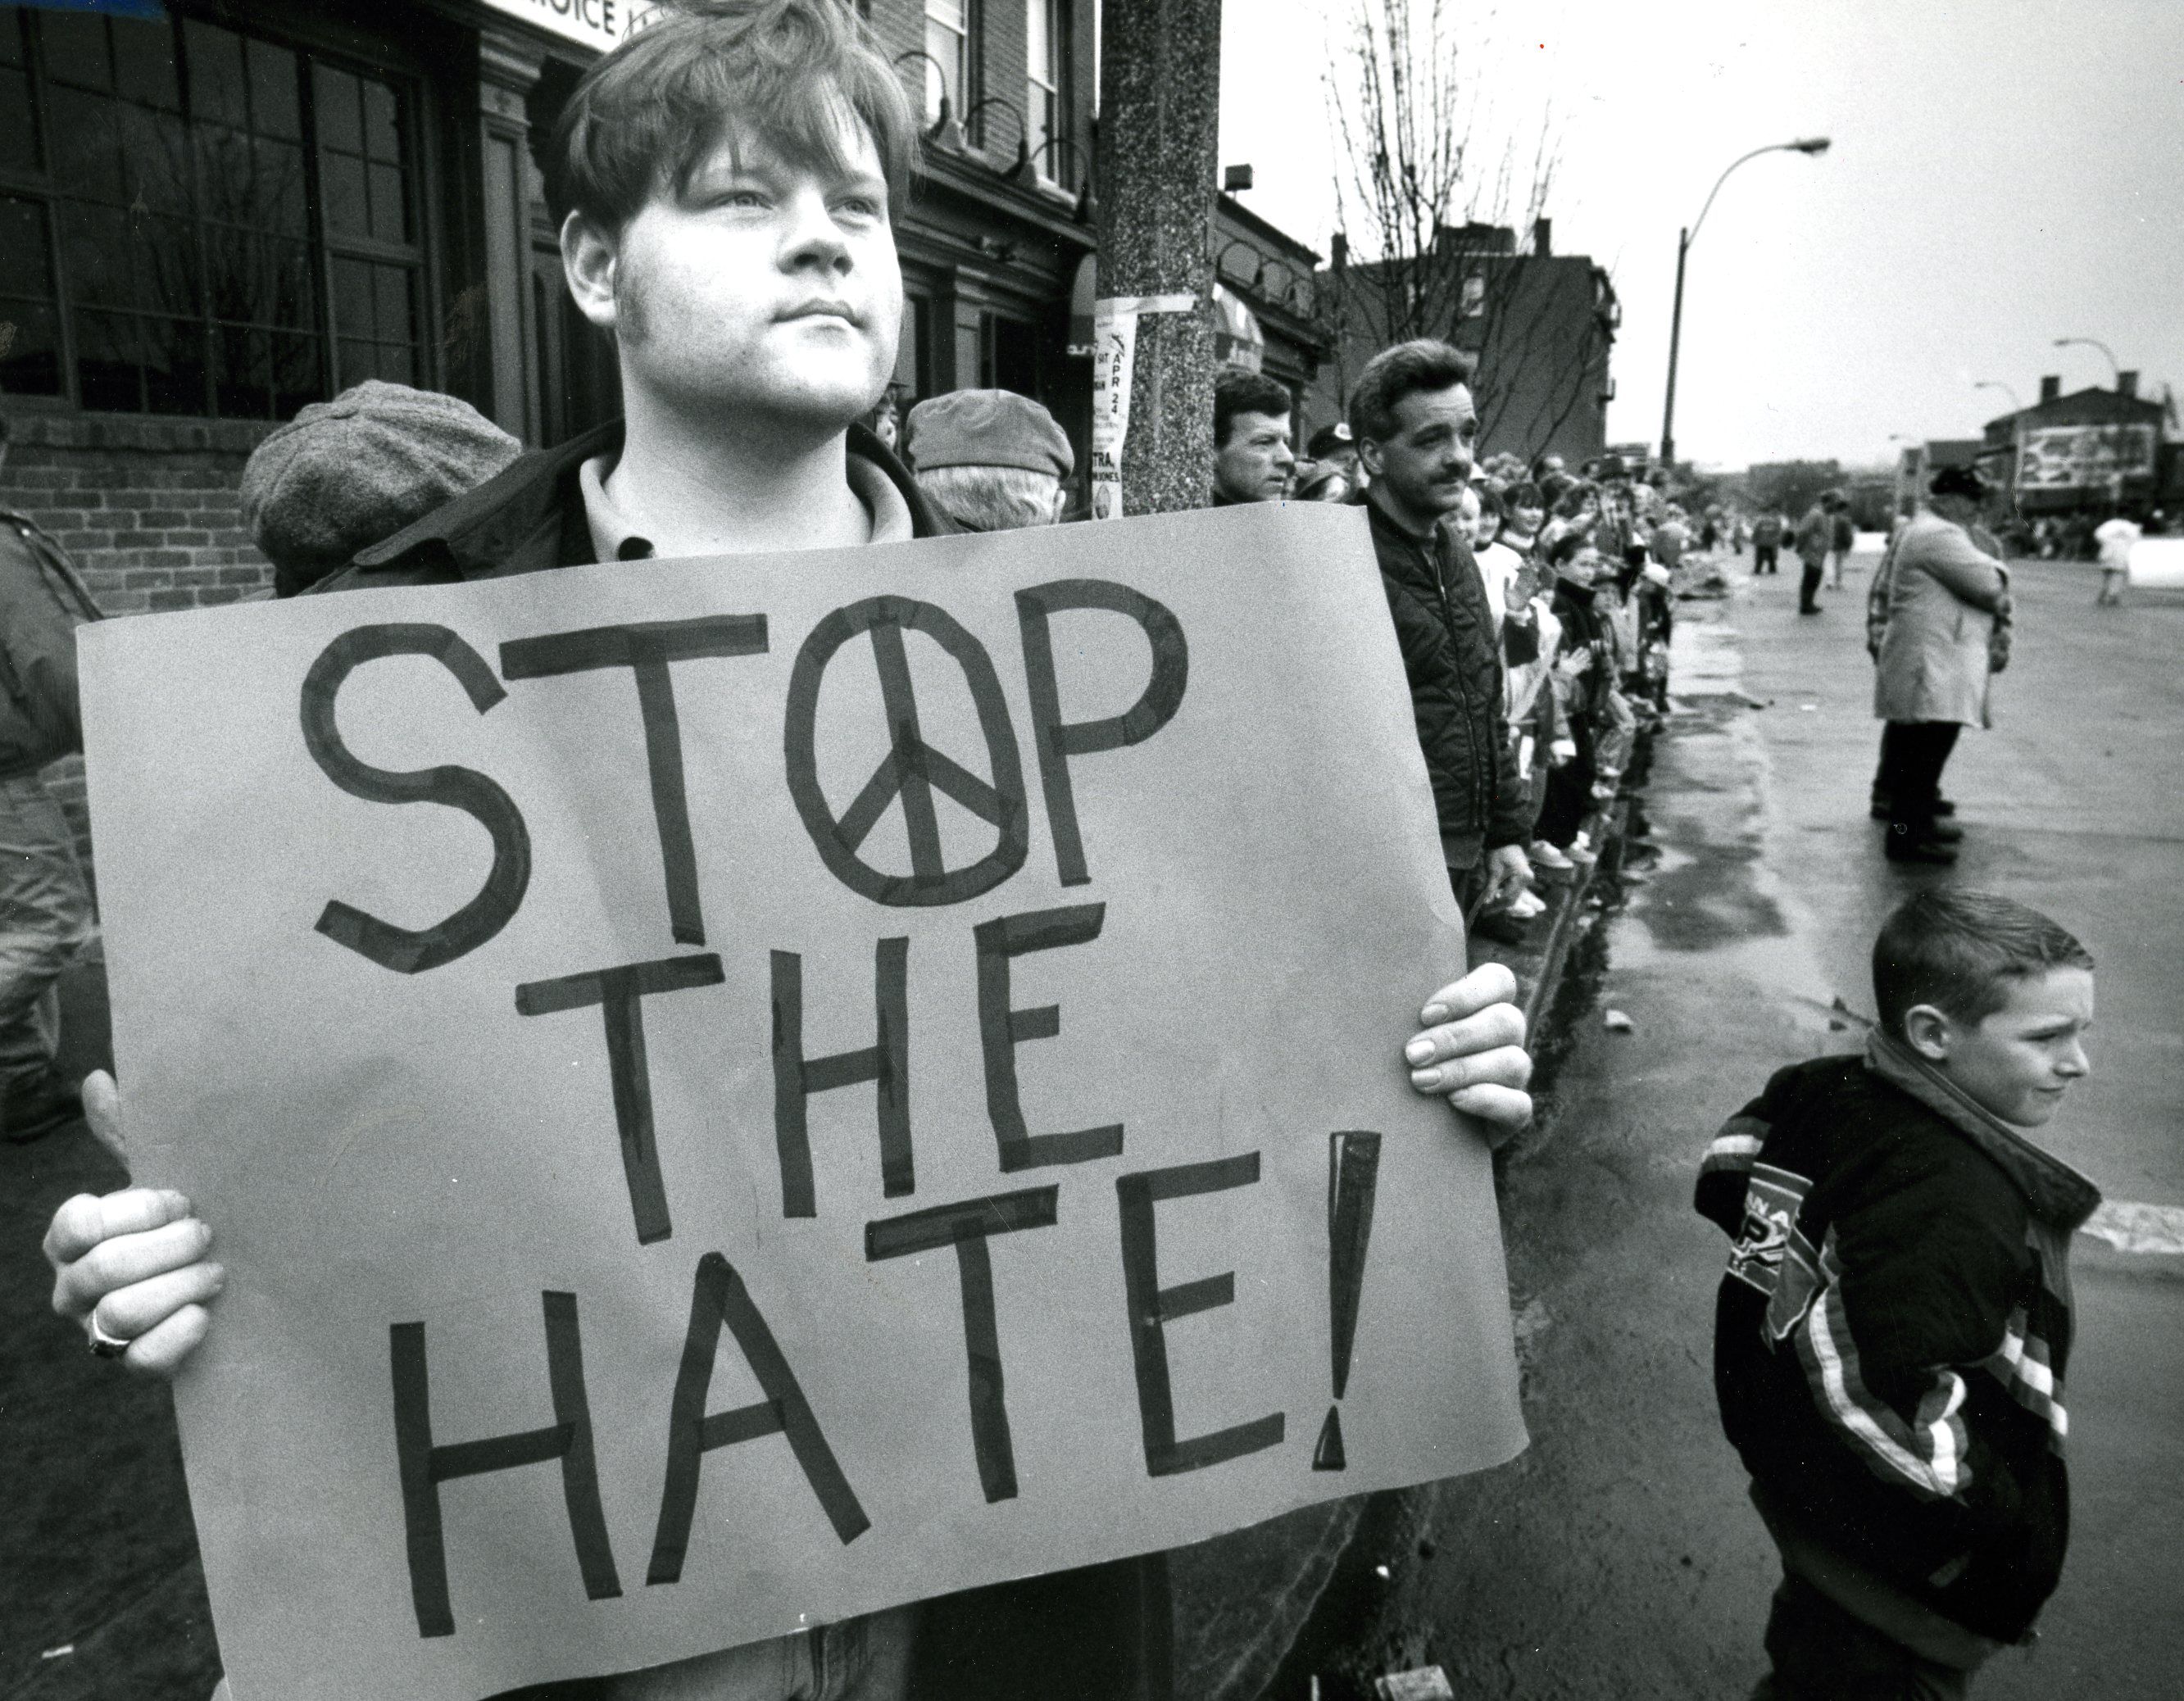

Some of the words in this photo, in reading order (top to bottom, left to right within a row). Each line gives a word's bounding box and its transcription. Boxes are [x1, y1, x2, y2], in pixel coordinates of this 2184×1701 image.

[300, 578, 1187, 973] STOP
[516, 902, 1124, 1245] THE
[389, 1131, 1382, 1639] HATE!
